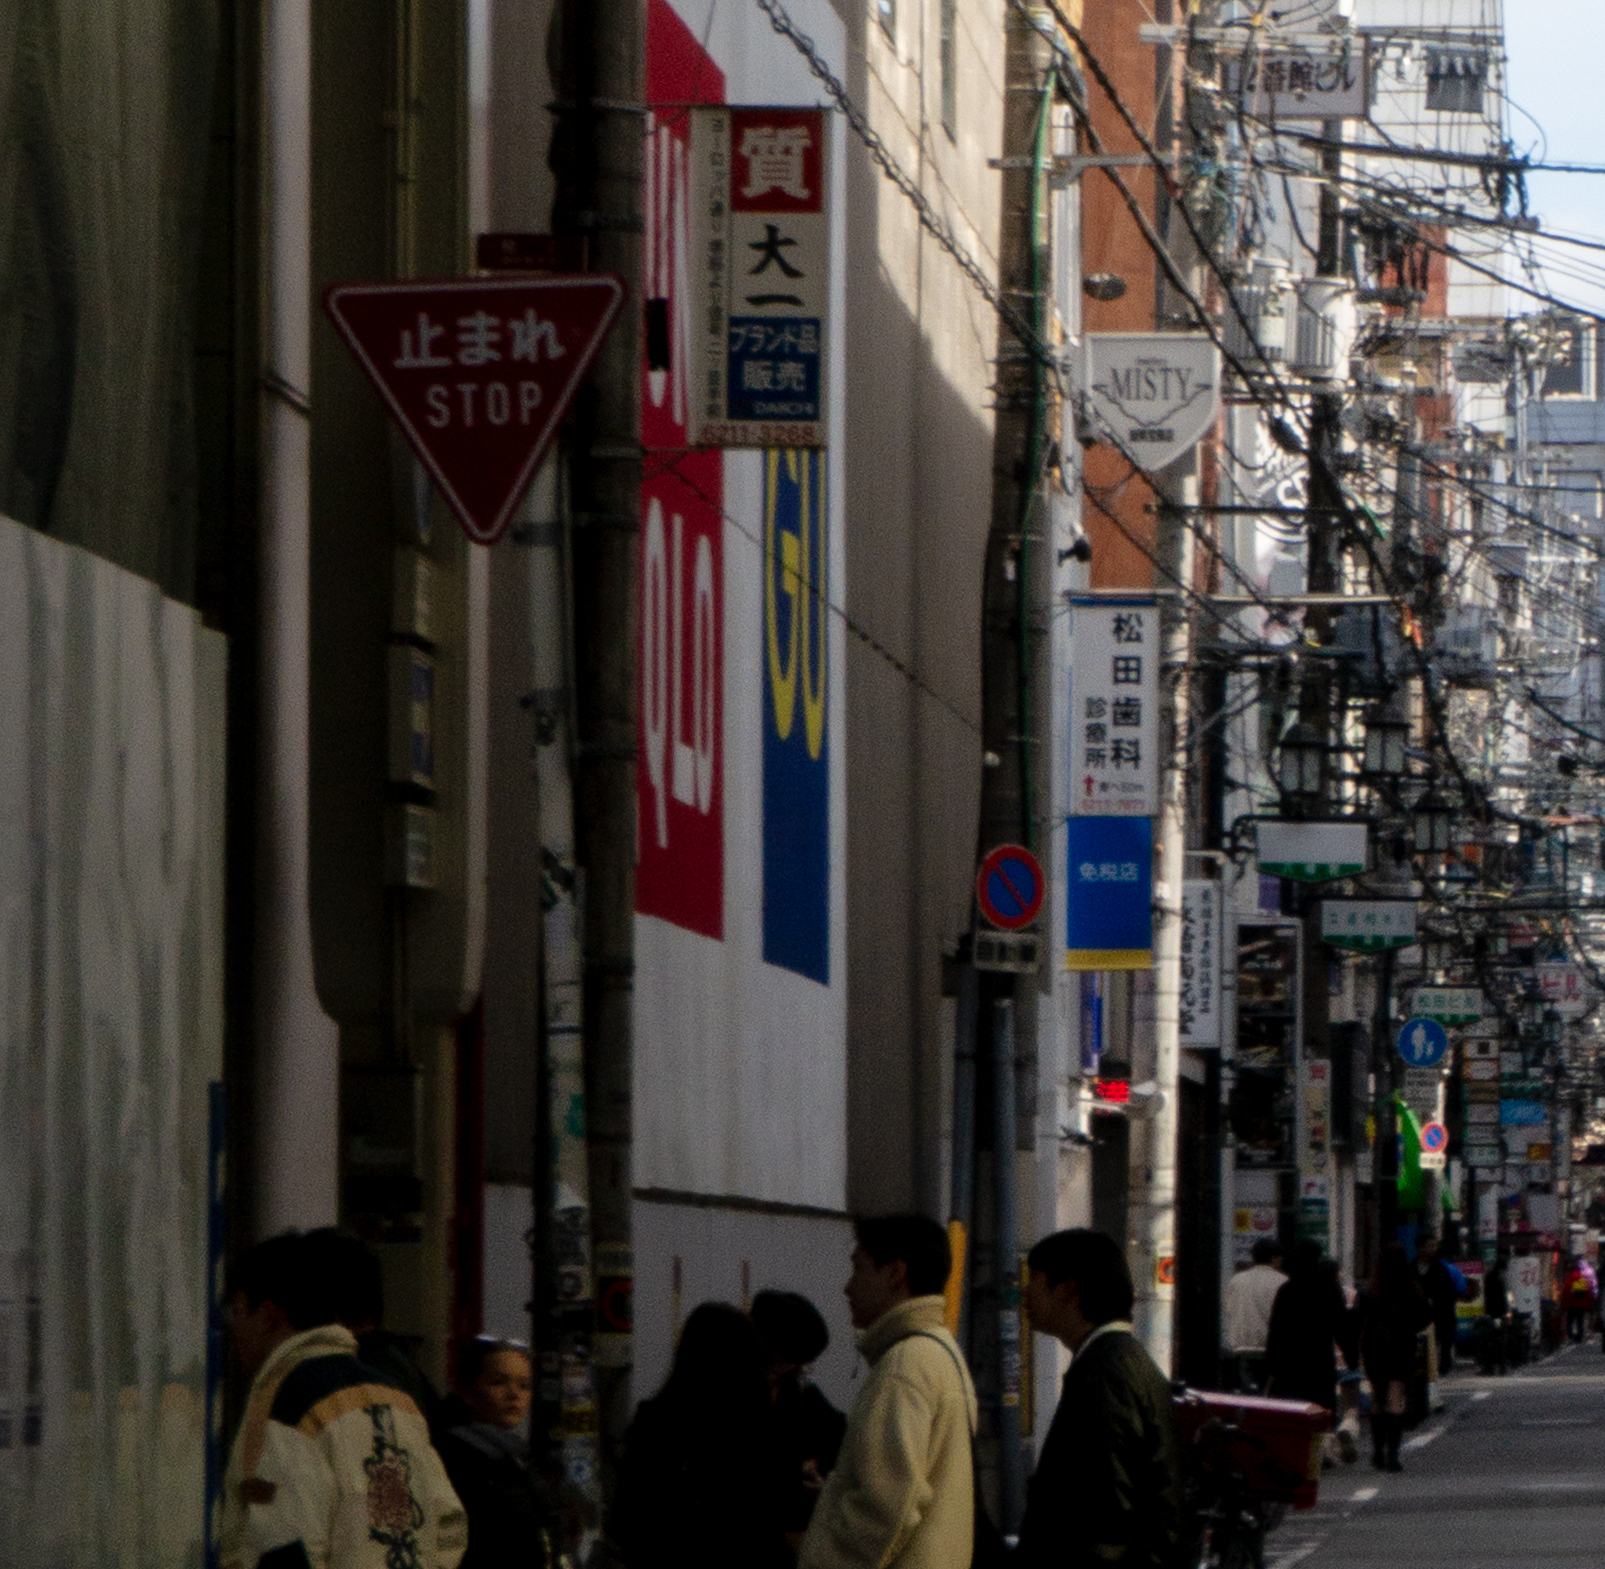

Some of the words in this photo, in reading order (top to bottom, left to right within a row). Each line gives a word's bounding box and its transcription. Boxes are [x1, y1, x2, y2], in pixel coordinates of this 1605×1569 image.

[738, 124, 813, 201] 質
[392, 305, 567, 369] 止まれ
[425, 381, 543, 430] STOP
[743, 358, 807, 393] 販売
[1110, 366, 1194, 401] MISTY
[765, 450, 826, 762] GU
[643, 494, 715, 851] QLO
[1111, 613, 1143, 770] 松田歯科
